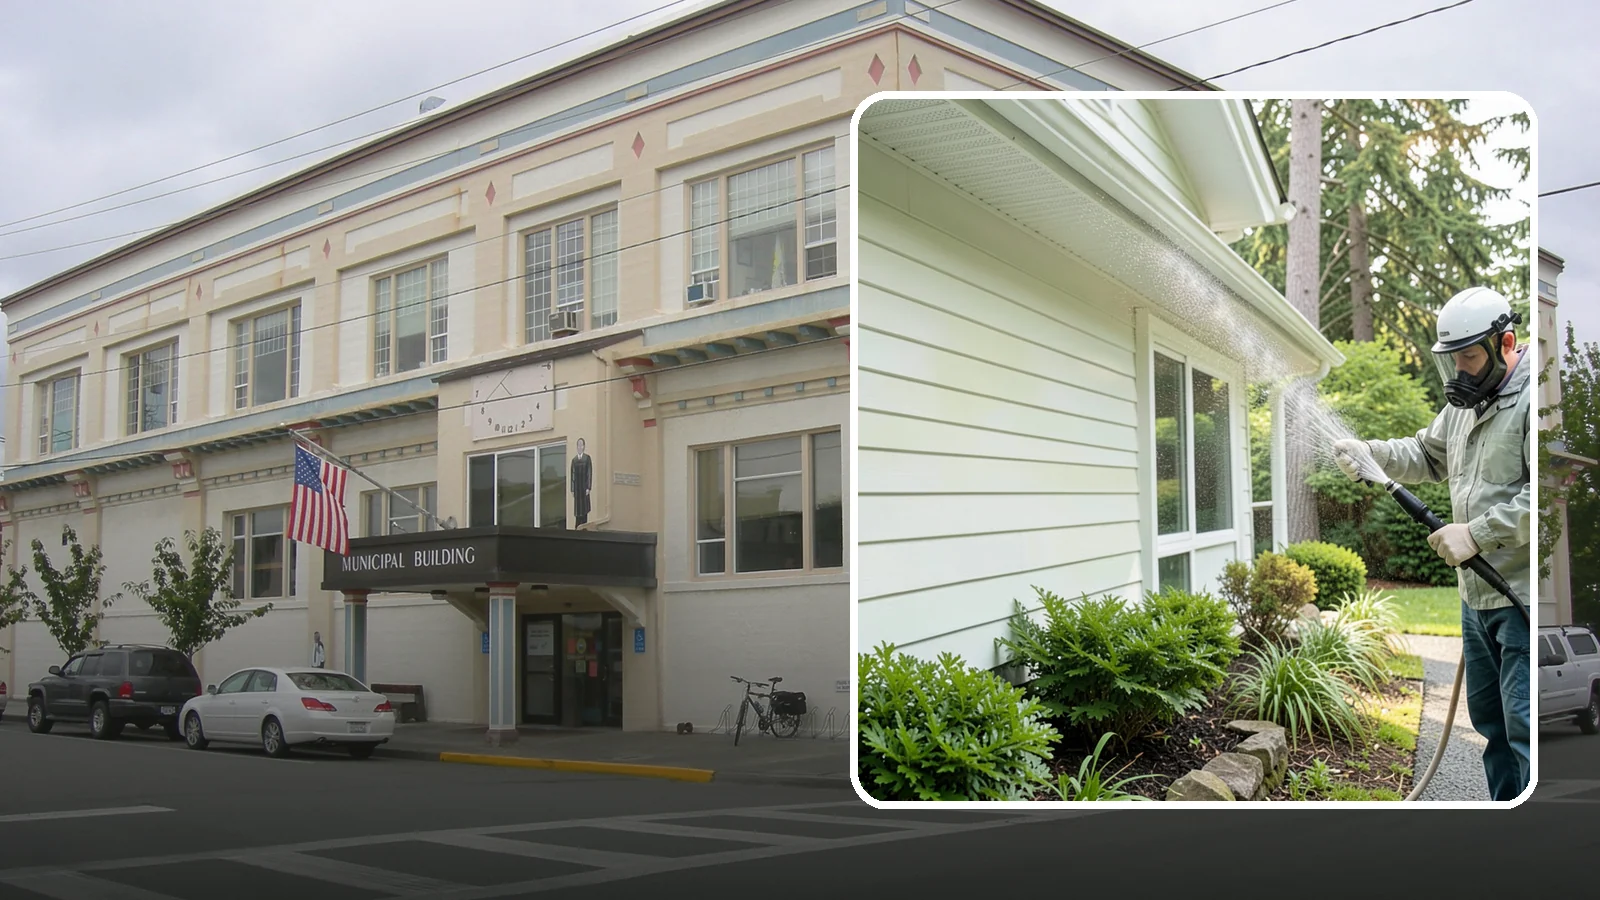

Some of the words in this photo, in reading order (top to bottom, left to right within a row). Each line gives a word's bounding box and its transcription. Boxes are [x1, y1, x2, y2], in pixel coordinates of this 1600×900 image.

[480, 407, 485, 415] 8
[487, 417, 492, 426] 9
[501, 425, 506, 433] 11
[507, 425, 513, 433] 12
[521, 420, 526, 428] 2
[529, 413, 533, 422] 3
[536, 402, 540, 410] 4
[342, 552, 405, 572] MUNICIPAL
[414, 546, 475, 567] BUILDING
